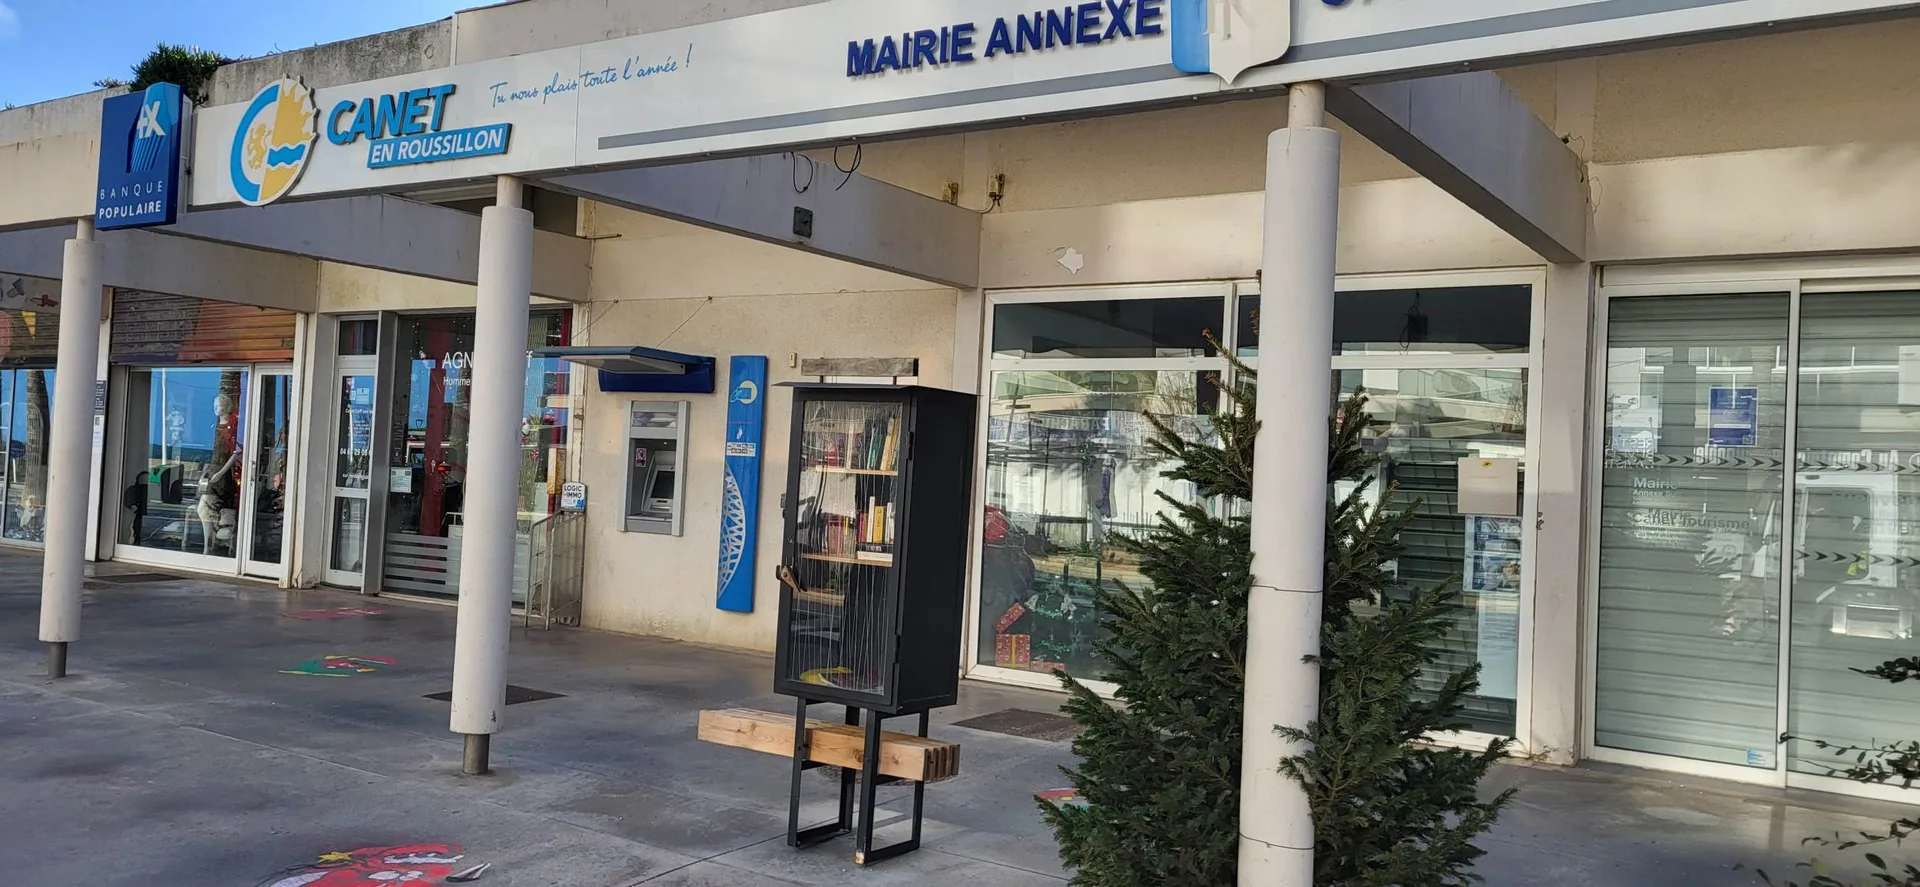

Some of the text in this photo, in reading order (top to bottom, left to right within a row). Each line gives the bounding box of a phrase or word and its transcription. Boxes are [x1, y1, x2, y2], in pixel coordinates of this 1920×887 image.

[847, 22, 976, 77] MAIRIE
[984, 0, 1162, 57] ANNEXE
[489, 81, 508, 107] Tu
[510, 89, 539, 100] nous
[542, 72, 578, 105] plais
[579, 67, 618, 88] toute
[622, 56, 679, 79] l'année
[327, 83, 456, 146] CANET
[371, 127, 503, 164] EN ROUSSILLON
[100, 180, 164, 200] BANQUE
[99, 200, 162, 219] POPULAIRE
[442, 351, 475, 369] AGN
[443, 376, 471, 387] Homme
[1633, 476, 1678, 490] Mairie
[1632, 489, 1663, 497] Annexe
[1680, 515, 1750, 530] Tourisme
